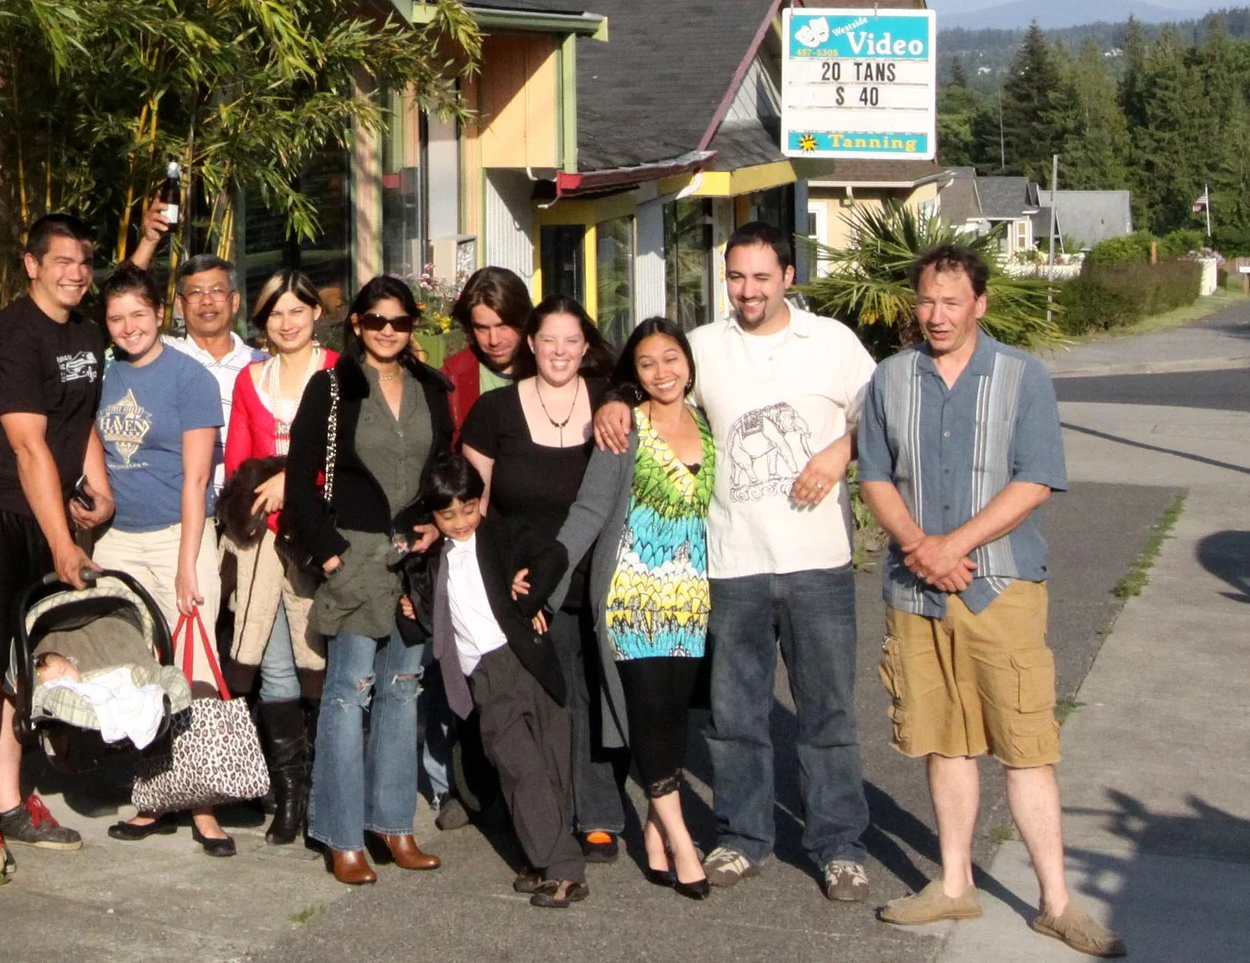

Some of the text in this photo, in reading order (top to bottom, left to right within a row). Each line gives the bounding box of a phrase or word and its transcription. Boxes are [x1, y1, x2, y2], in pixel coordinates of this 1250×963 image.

[831, 16, 868, 37] Westside
[846, 31, 924, 55] Video
[821, 62, 896, 82] 20 TANS
[859, 87, 879, 106] 40
[828, 134, 917, 152] Tanning
[100, 416, 146, 432] HAVEN
